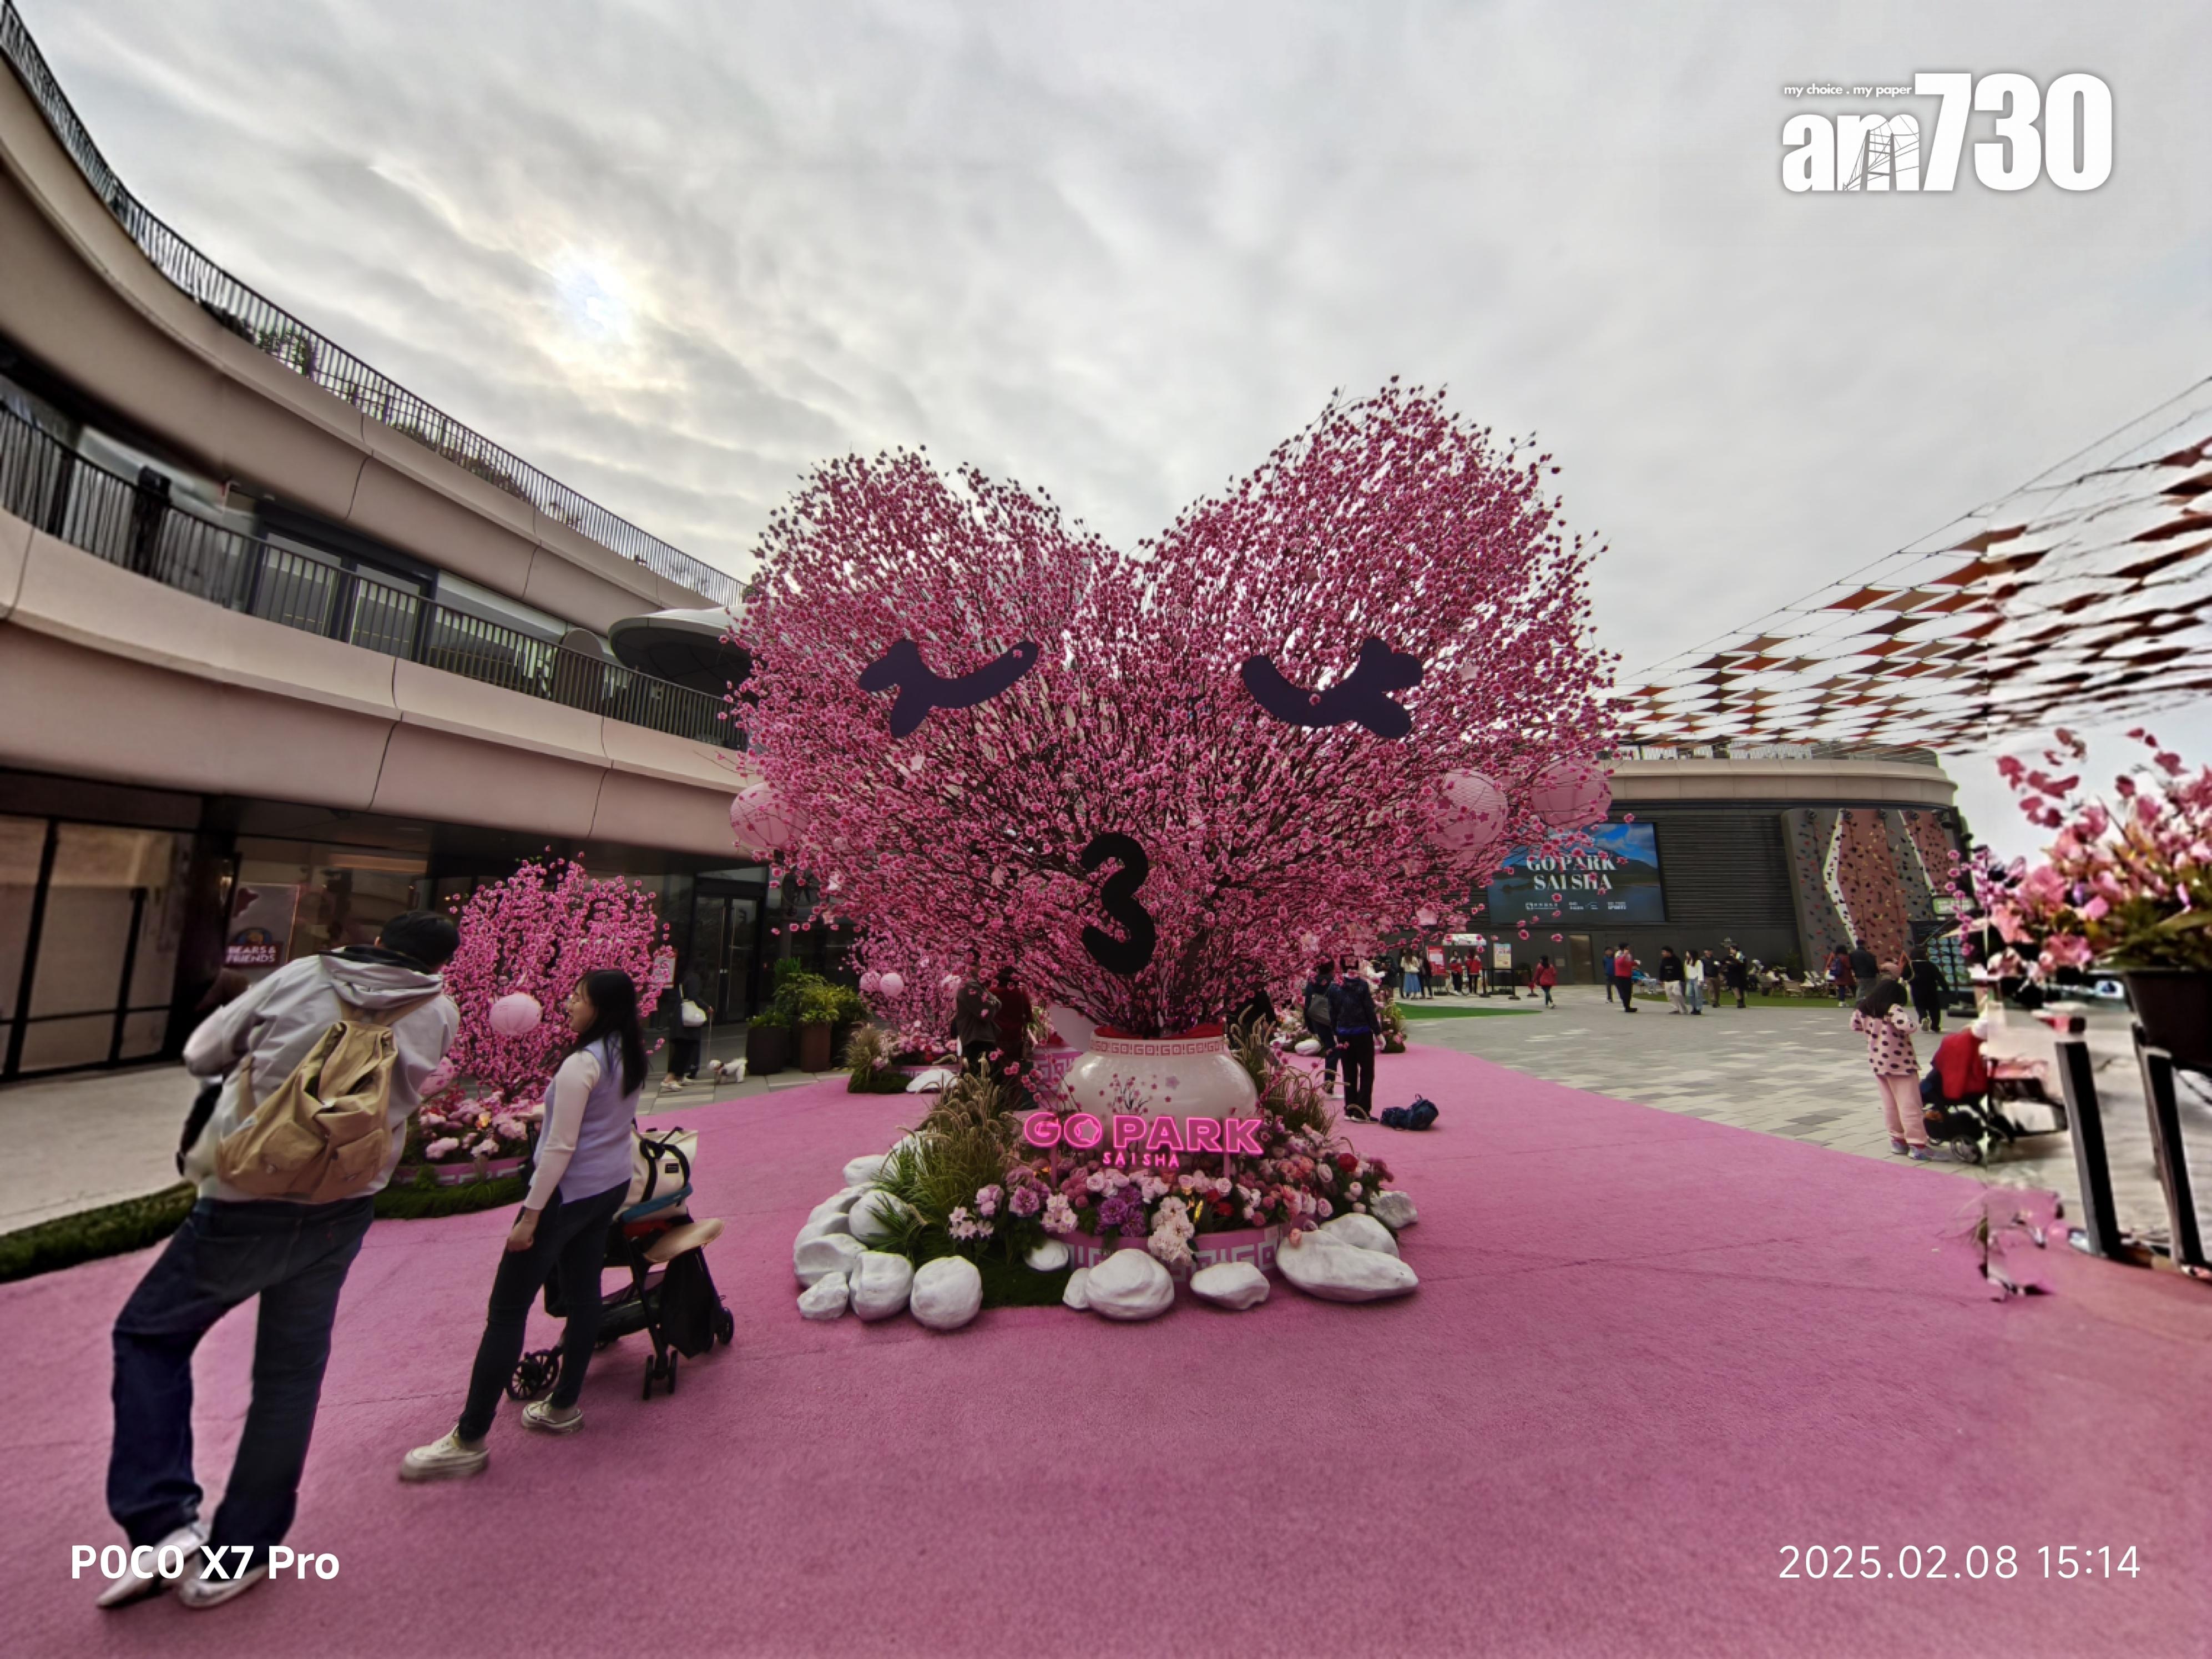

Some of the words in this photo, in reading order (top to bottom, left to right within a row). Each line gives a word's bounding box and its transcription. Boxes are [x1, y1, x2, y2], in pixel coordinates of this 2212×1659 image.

[225, 954, 275, 964] FRIENDS
[1023, 1111, 1103, 1148] GO
[1112, 1114, 1264, 1155] PARK
